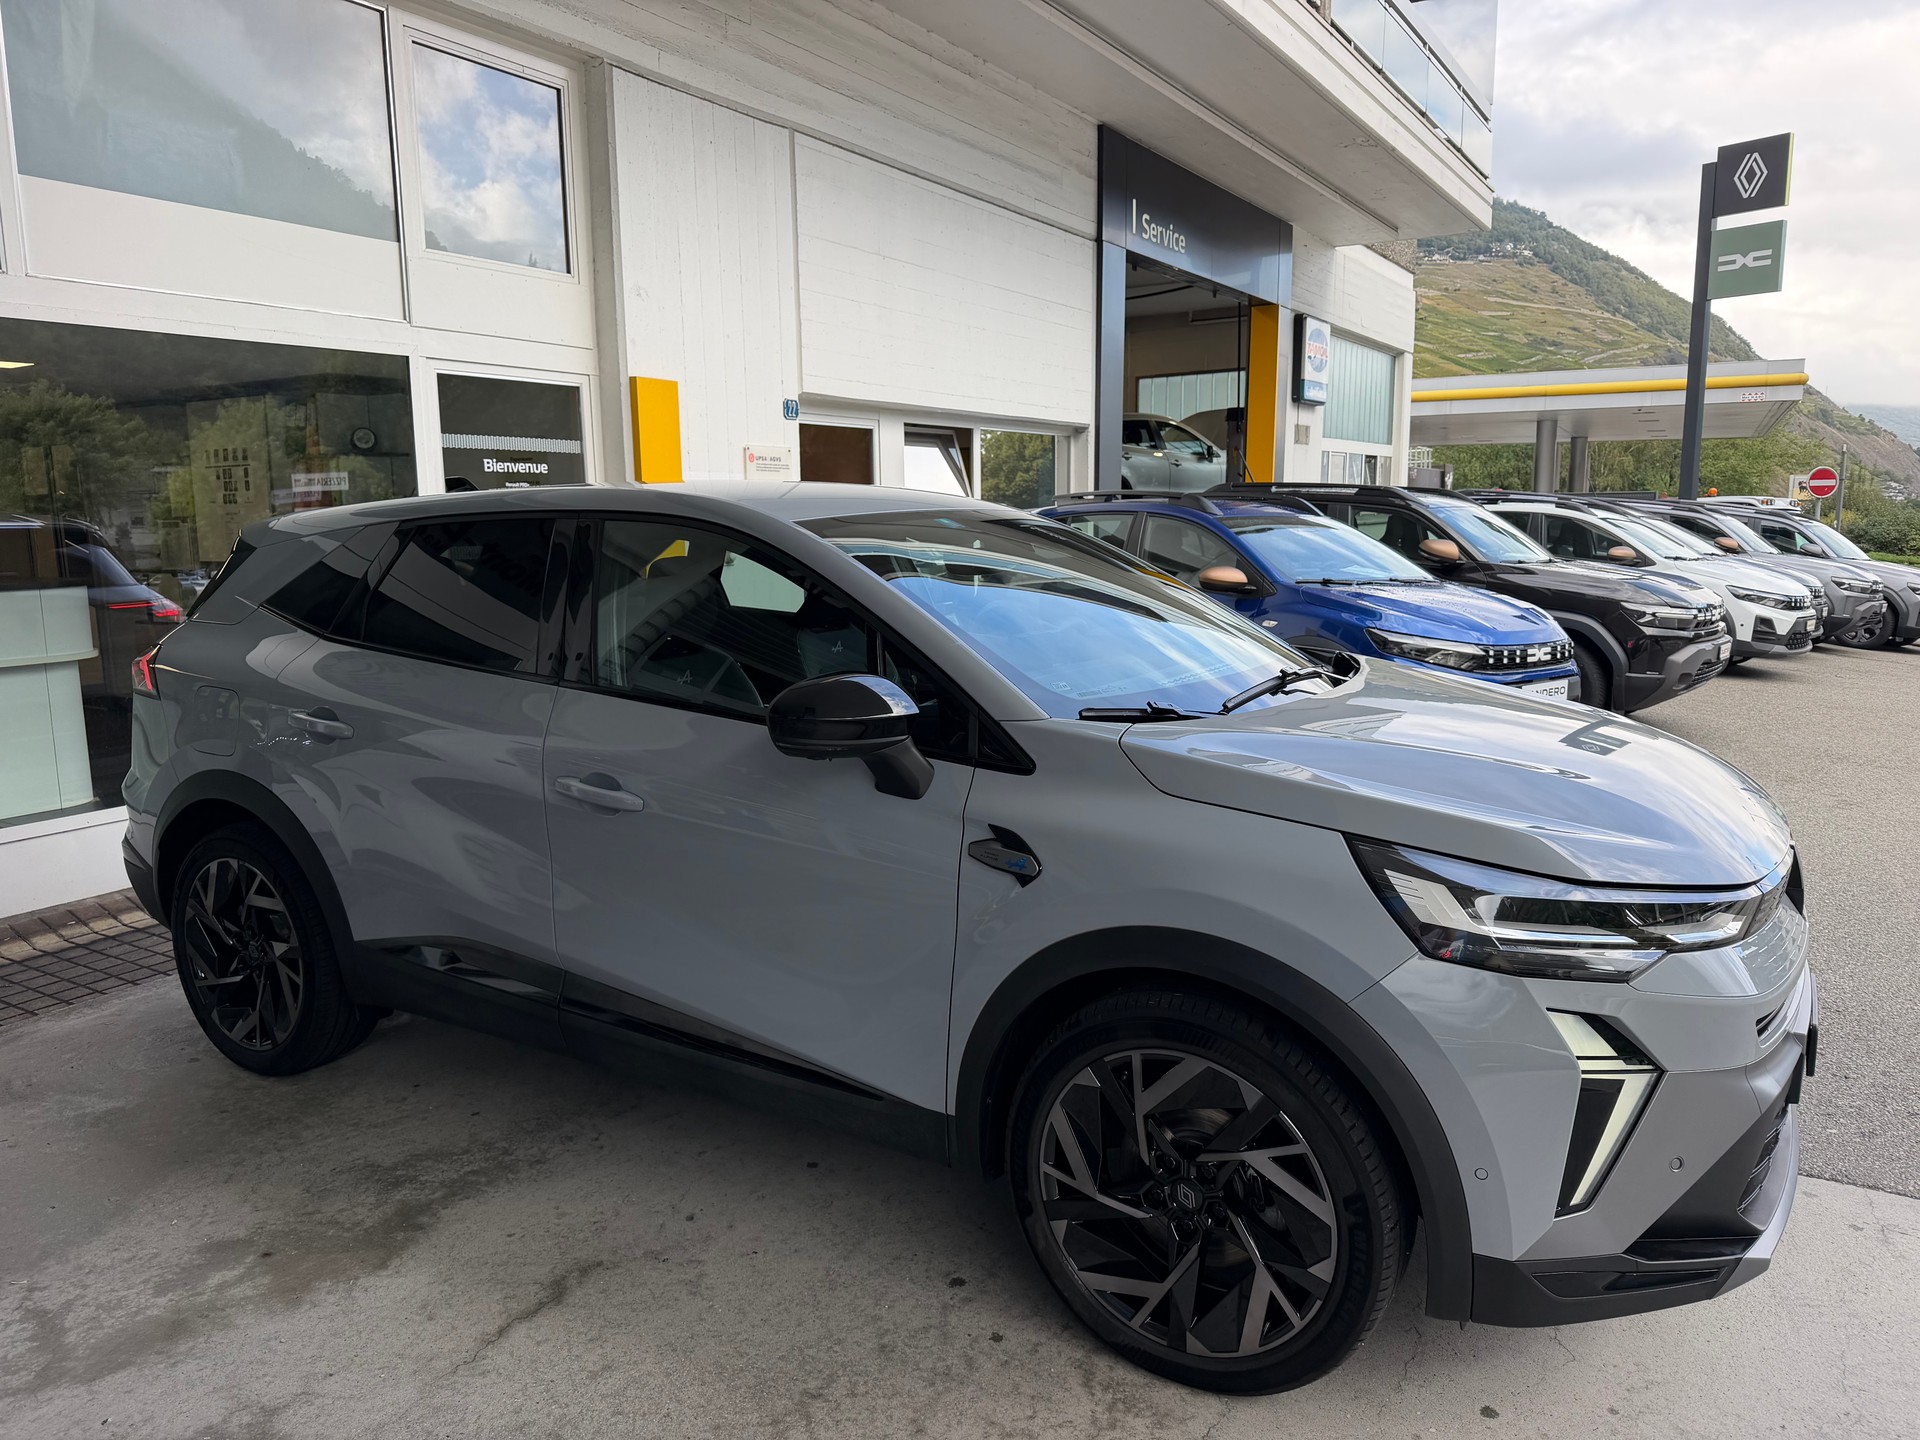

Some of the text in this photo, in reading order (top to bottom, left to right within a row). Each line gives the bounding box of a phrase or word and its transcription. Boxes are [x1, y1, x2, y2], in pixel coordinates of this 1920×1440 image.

[1142, 213, 1186, 254] Service
[787, 400, 797, 417] 22
[483, 458, 549, 474] Bienvenue
